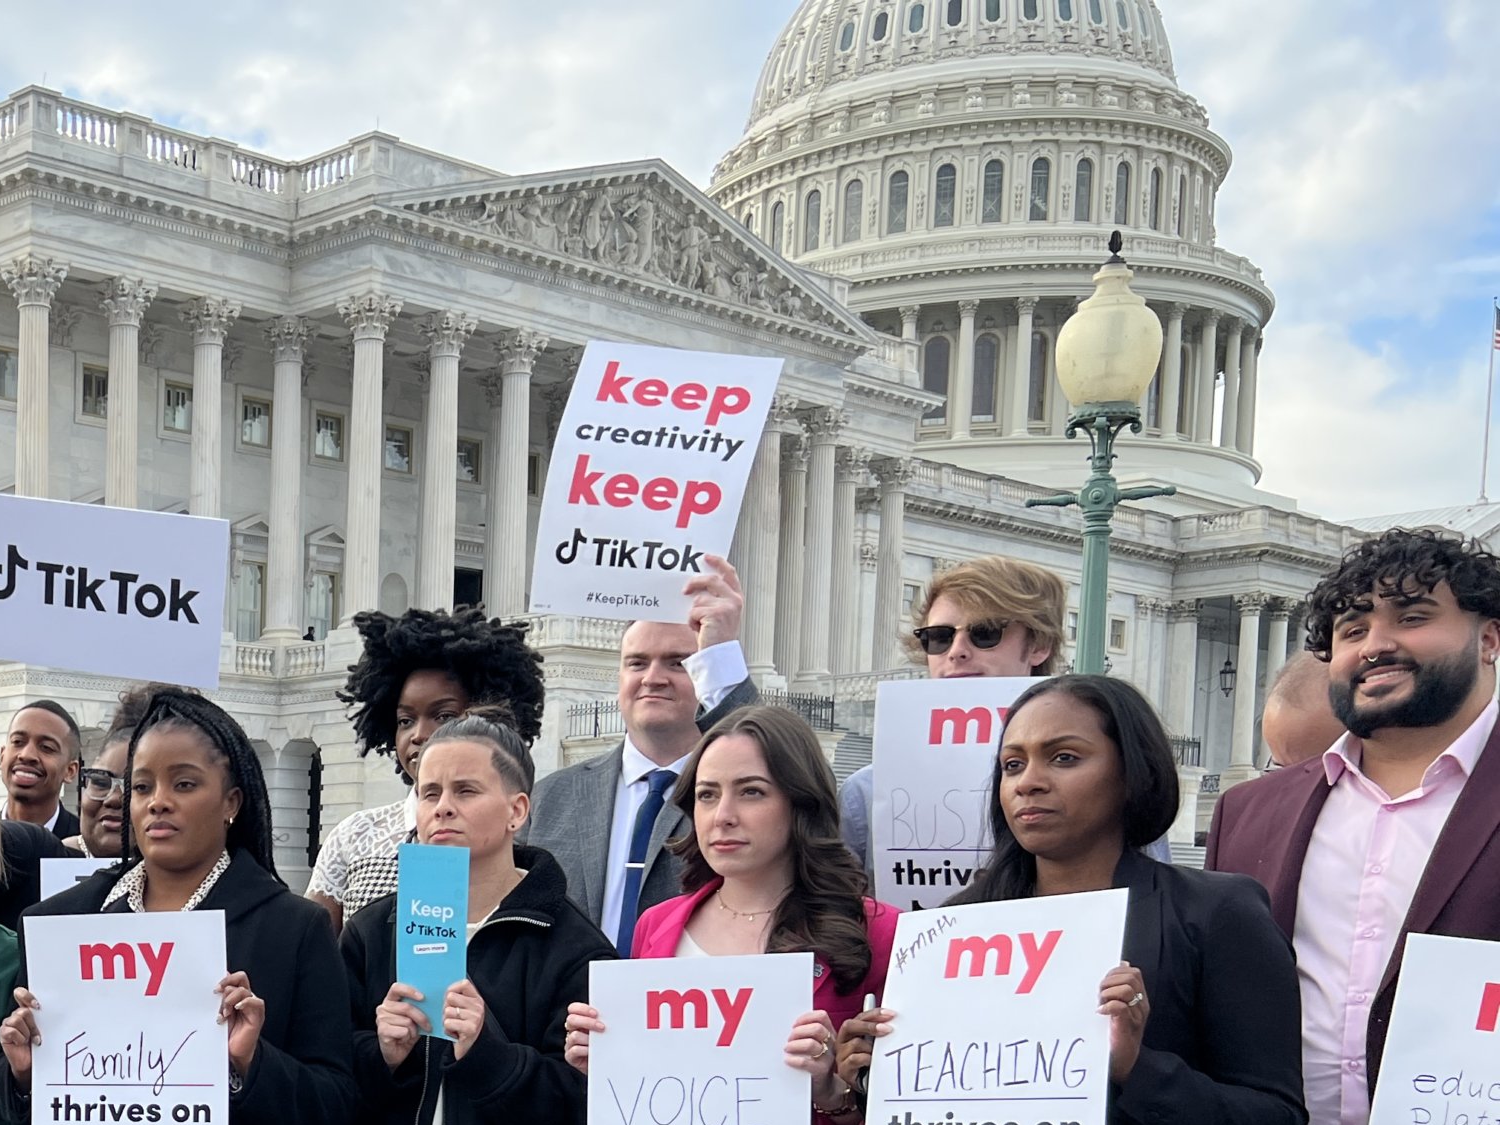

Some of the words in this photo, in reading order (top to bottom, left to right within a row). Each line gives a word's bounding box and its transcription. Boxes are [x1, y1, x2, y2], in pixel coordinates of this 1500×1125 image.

[595, 361, 751, 426] keep
[575, 424, 744, 462] creativity
[568, 454, 722, 528] keep
[592, 538, 705, 573] TikTok
[36, 562, 200, 625] TikTok
[586, 592, 660, 608] #KeepTikTok
[928, 706, 1011, 746] m
[411, 899, 454, 923] Keep
[418, 924, 457, 939] TikTok
[79, 941, 175, 996] my
[944, 930, 1064, 994] my
[646, 988, 754, 1047] my
[65, 1030, 197, 1096] Family
[885, 1038, 1087, 1097] TEACHING
[51, 1094, 162, 1122] thrives
[171, 1104, 212, 1123] on
